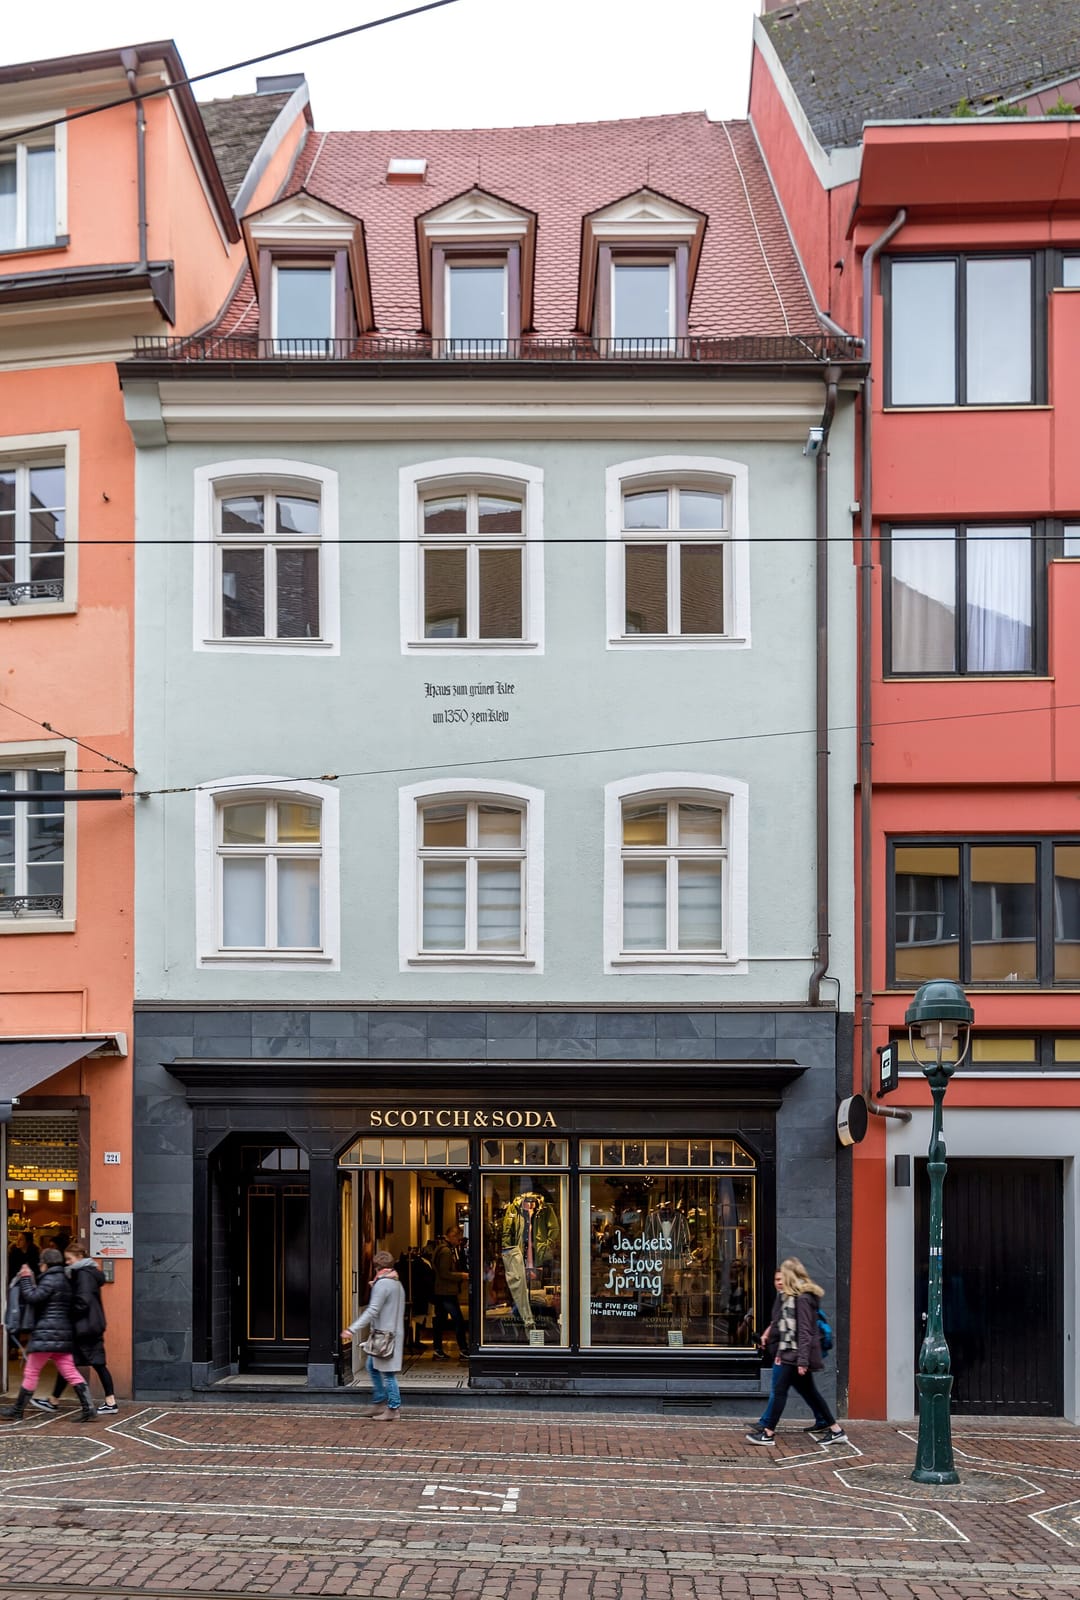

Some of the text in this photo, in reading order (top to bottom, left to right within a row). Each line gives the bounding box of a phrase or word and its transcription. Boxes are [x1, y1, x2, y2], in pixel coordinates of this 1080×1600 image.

[424, 681, 515, 698] Haus zum grünen Klee
[444, 708, 469, 723] 1350
[369, 1109, 558, 1128] SCOTCH&SODA
[106, 1154, 118, 1163] 221
[613, 1229, 673, 1251] Jackets
[608, 1251, 663, 1273] that Love
[604, 1268, 662, 1296] Spring
[590, 1309, 637, 1317] IN-BETWEEN
